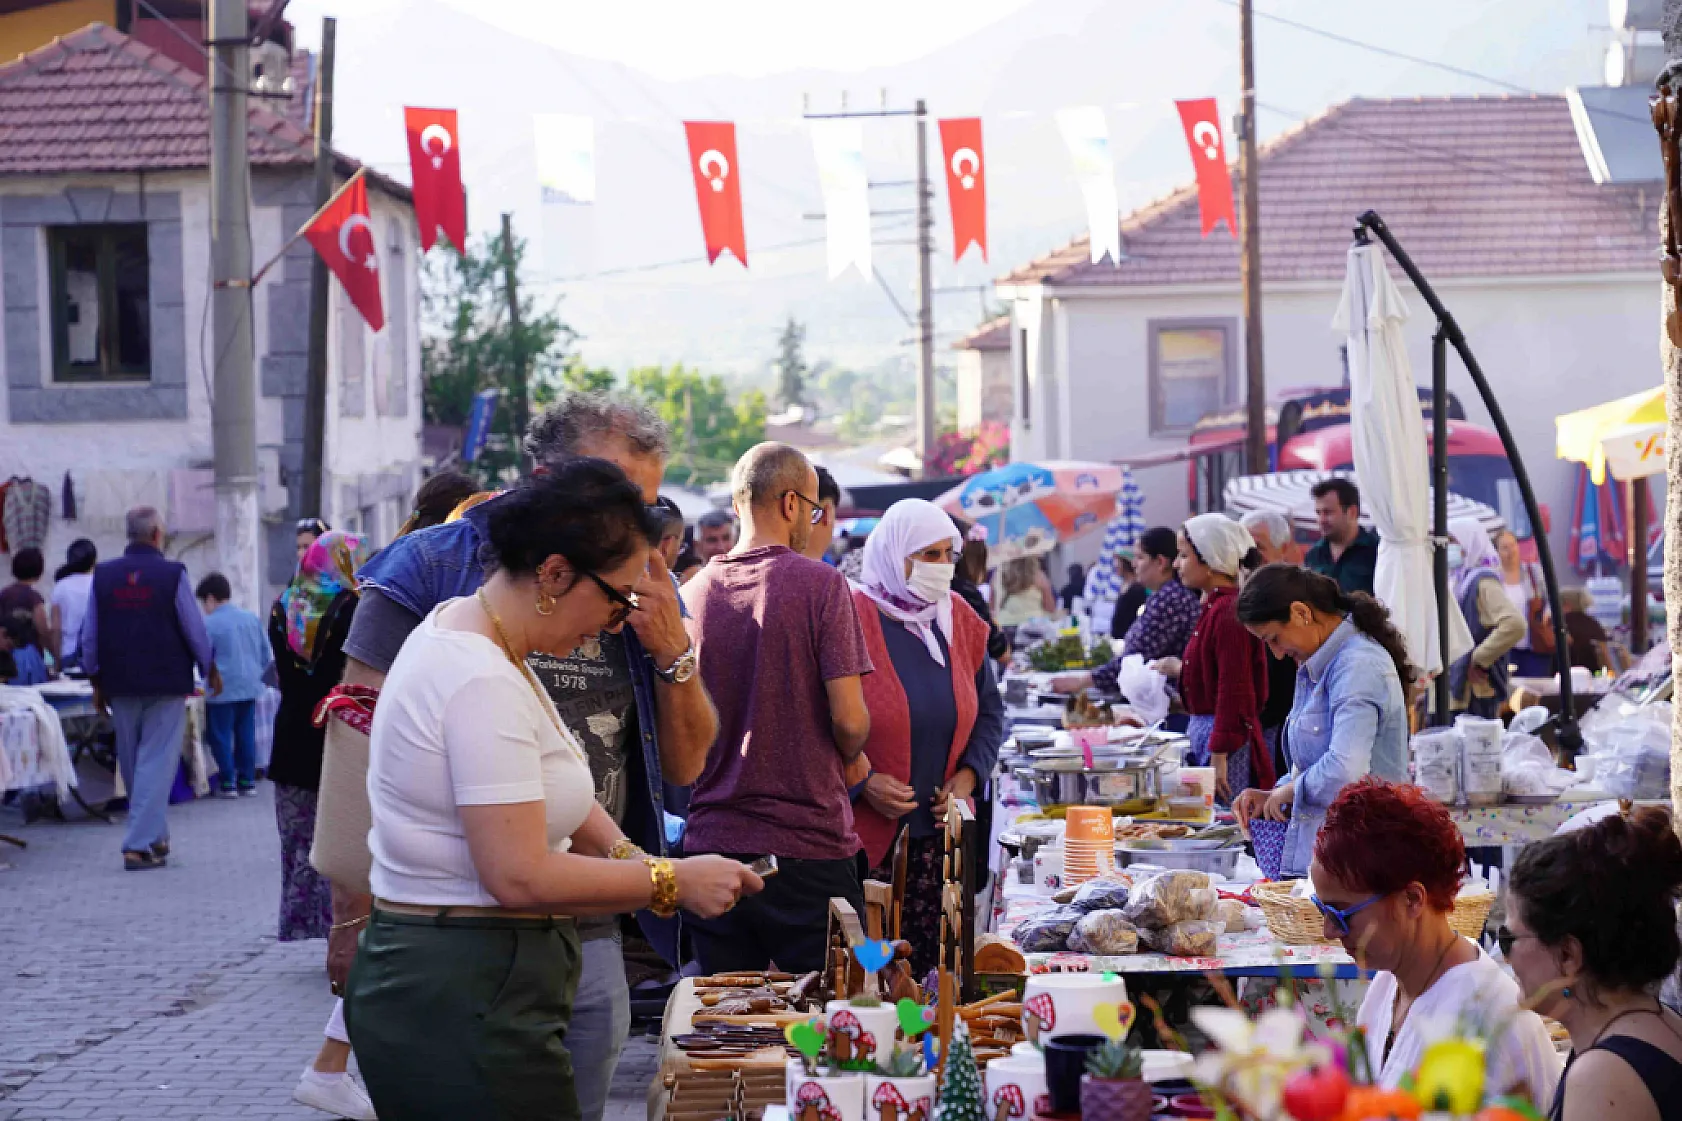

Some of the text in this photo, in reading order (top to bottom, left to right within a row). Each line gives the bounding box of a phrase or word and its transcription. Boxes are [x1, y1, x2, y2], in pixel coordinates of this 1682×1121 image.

[527, 657, 580, 673] Worldwide
[553, 673, 587, 690] 1978
[604, 687, 628, 706] PH
